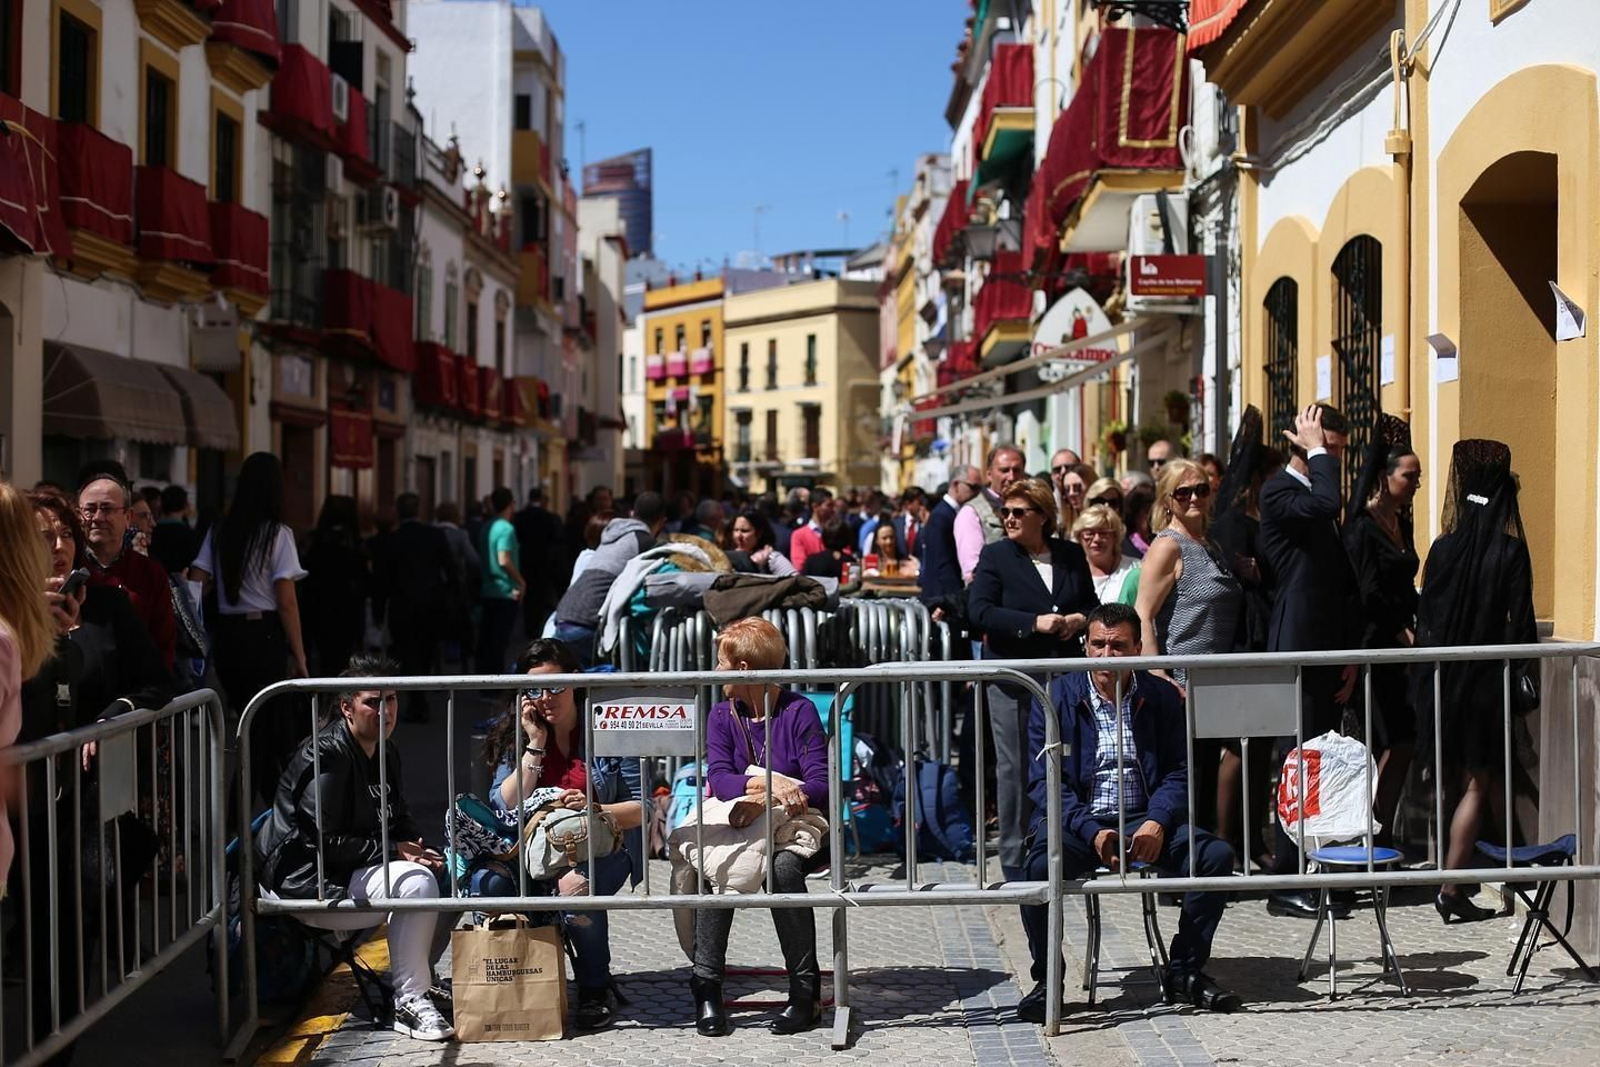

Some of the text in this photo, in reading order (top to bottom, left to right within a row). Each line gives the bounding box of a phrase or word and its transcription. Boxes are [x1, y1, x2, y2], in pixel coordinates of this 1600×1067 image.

[604, 705, 687, 719] REMSA
[610, 721, 620, 729] 954
[621, 721, 627, 729] 40
[628, 721, 635, 729] 50
[635, 721, 642, 729] 21
[486, 968, 543, 977] HAMBURGUESAS
